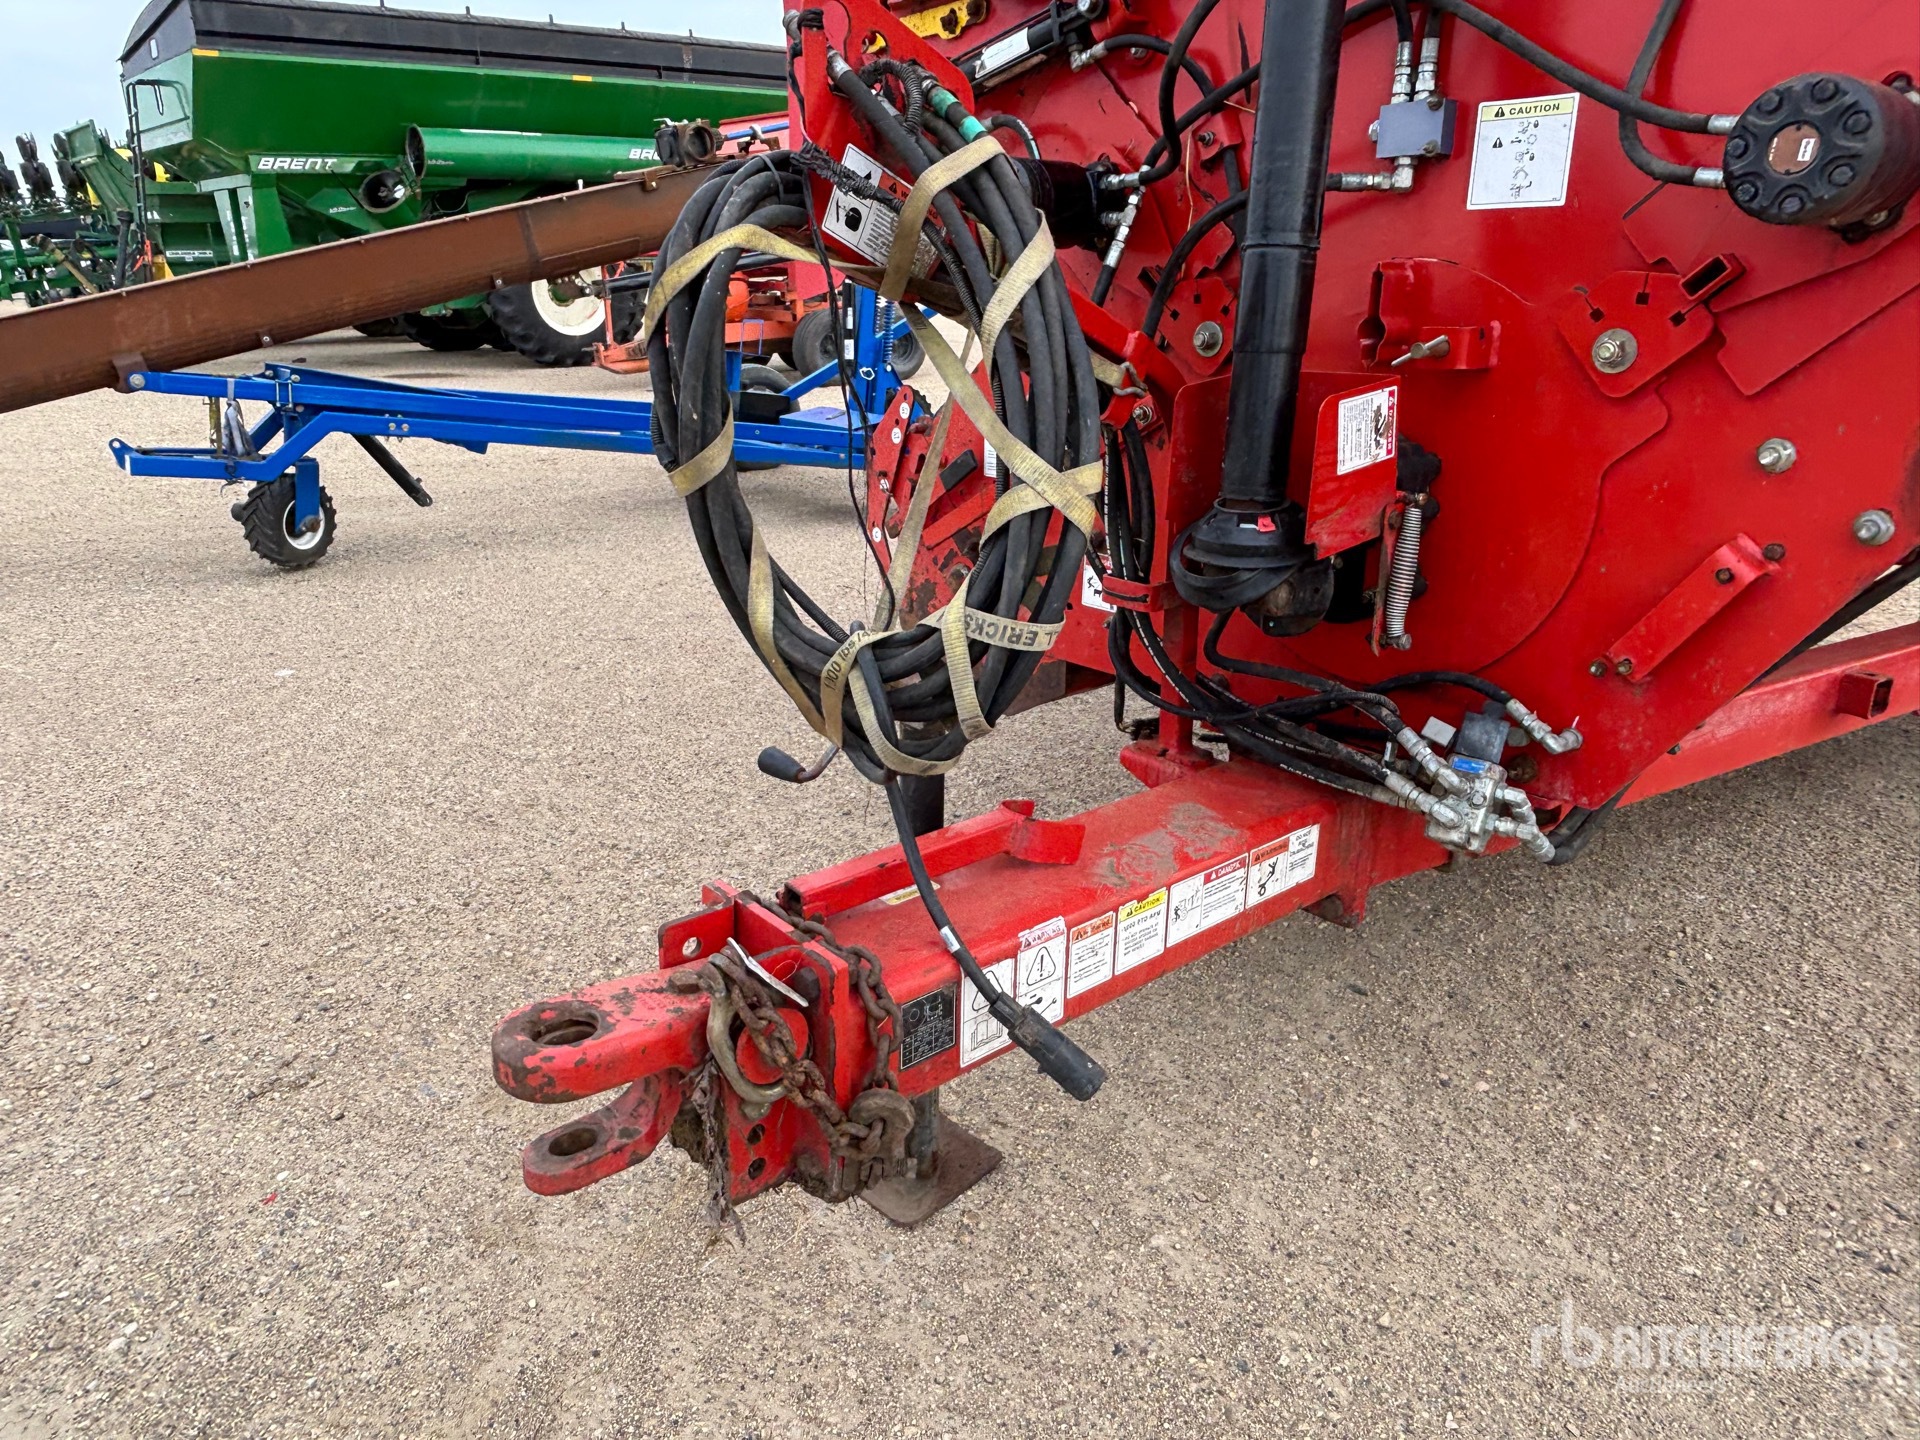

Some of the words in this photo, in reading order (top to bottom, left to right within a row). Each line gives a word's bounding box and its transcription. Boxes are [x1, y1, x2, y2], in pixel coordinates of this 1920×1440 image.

[1509, 103, 1560, 116] CAUTION
[258, 158, 337, 170] BRENT
[1134, 896, 1161, 913] CAUTION
